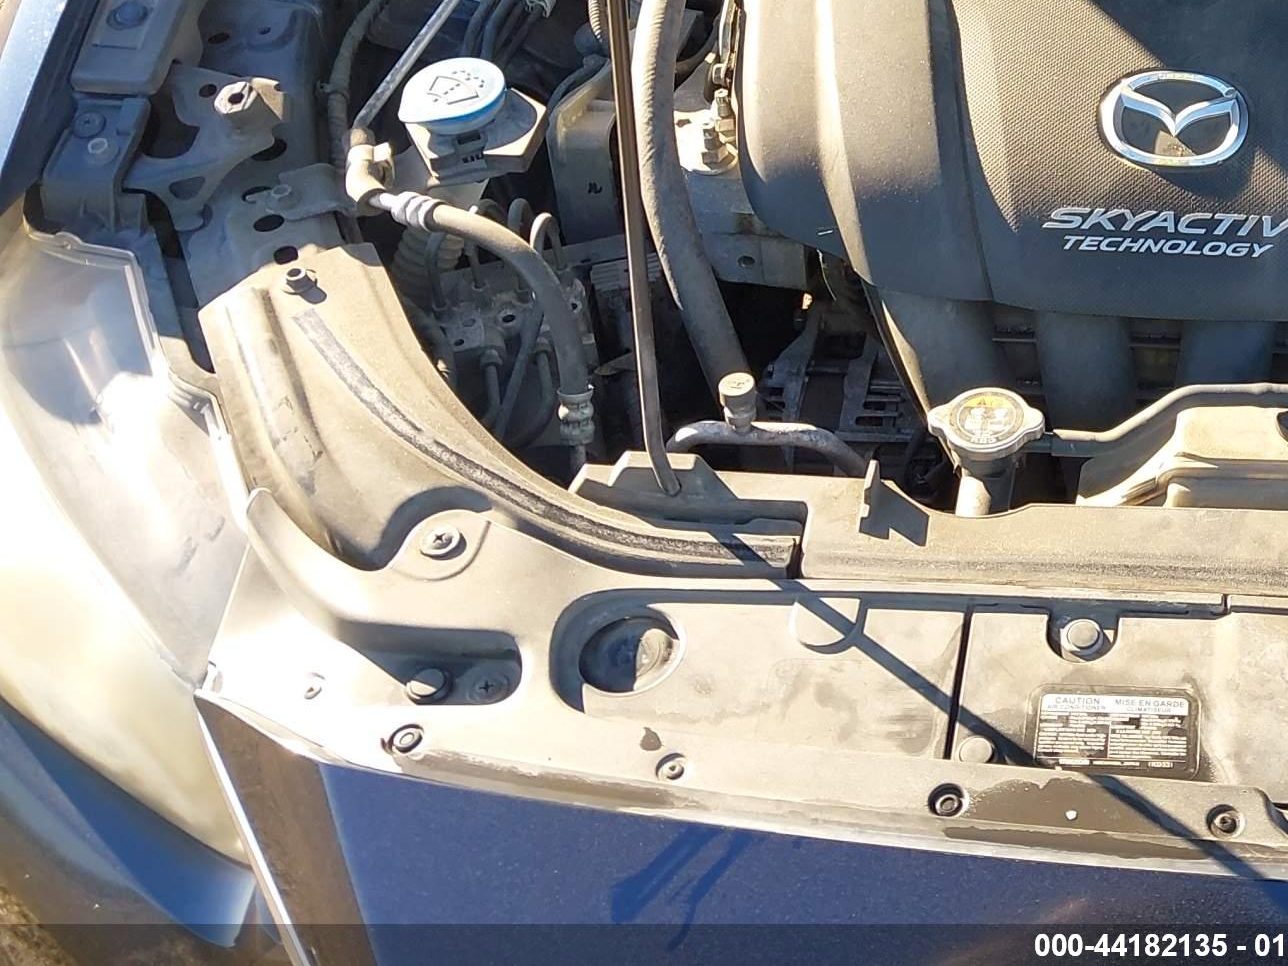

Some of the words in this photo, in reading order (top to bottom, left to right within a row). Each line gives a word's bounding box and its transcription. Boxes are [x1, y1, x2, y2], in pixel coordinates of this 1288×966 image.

[1063, 235, 1275, 258] TECHNOLOGY
[1055, 696, 1100, 705] CAUTION
[1115, 698, 1136, 706] MISE
[1138, 699, 1151, 707] EN
[1153, 700, 1185, 708] GARDE
